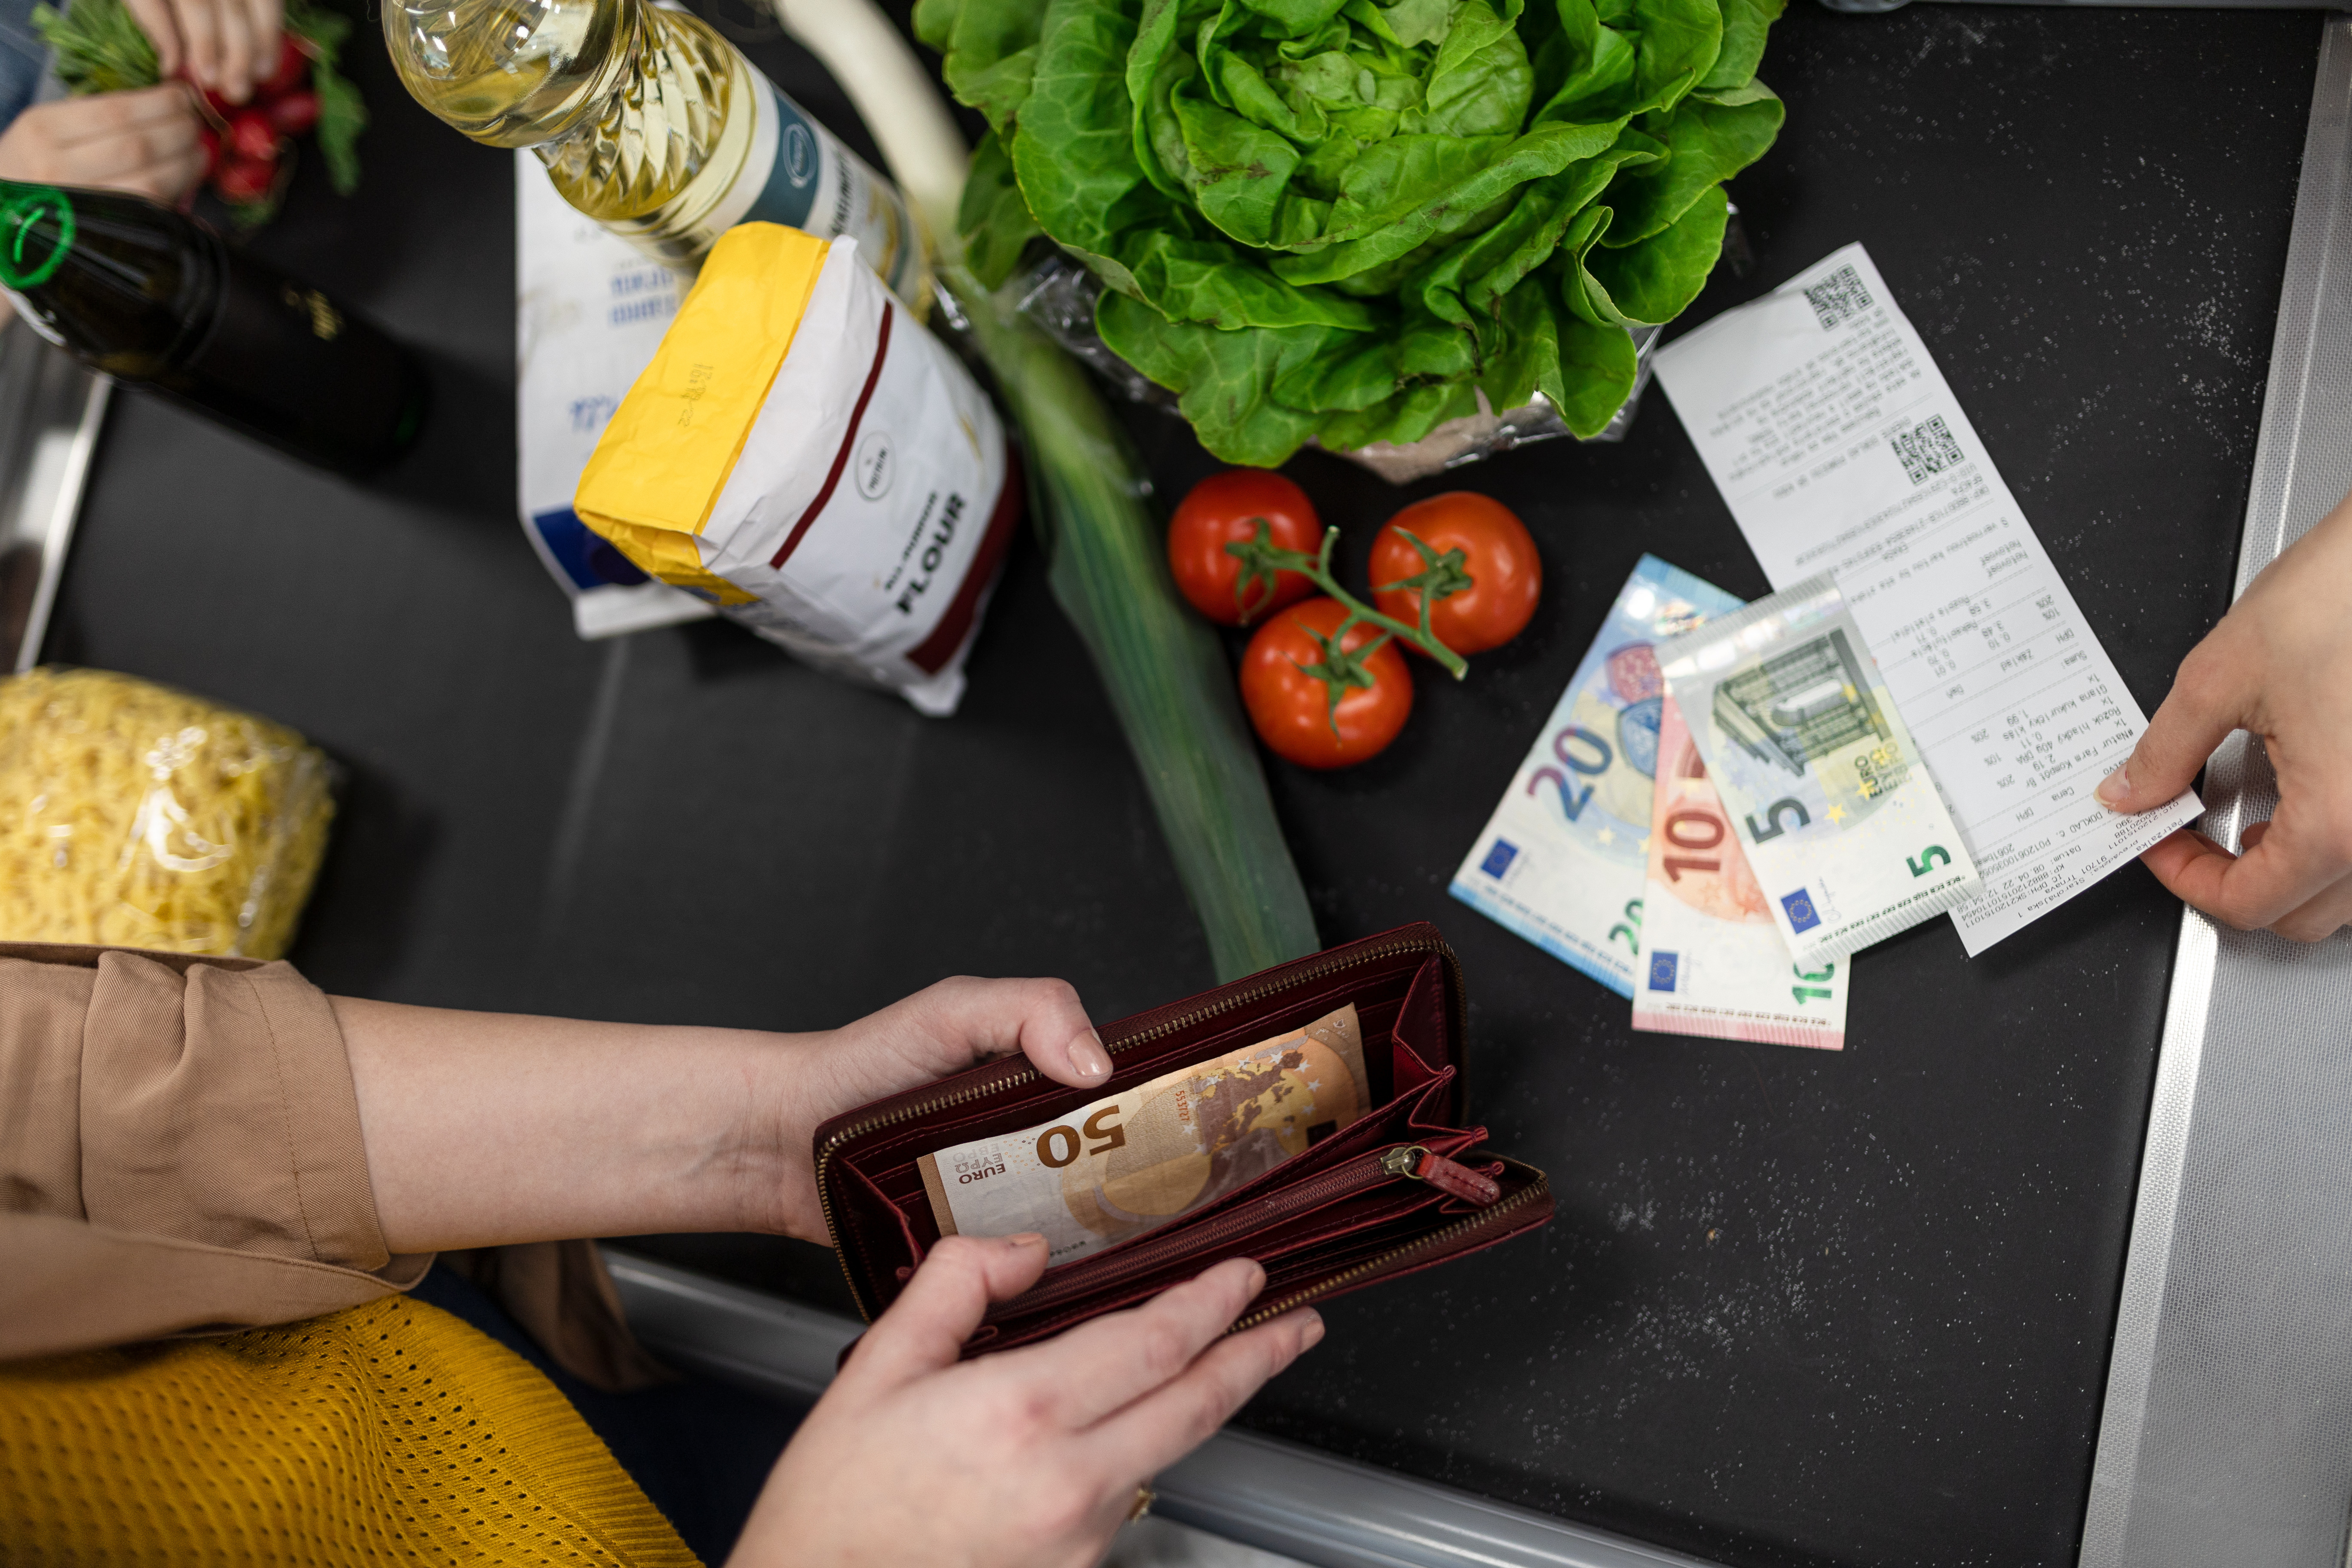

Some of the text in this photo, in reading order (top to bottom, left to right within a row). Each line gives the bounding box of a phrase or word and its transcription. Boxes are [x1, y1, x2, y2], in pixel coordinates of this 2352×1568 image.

[897, 493, 965, 616] FLOUR
[2035, 594, 2055, 611] 20%
[2041, 605, 2061, 622] 10%
[2055, 627, 2075, 644] DPH
[2059, 649, 2088, 670] Suma:
[2078, 683, 2108, 704] Giana
[2100, 695, 2113, 707] 1x
[1970, 672, 2100, 745] 1x 1.99 20%
[2027, 698, 2077, 730] kukuričky
[2091, 705, 2121, 726] Rožok
[2055, 720, 2090, 745] hladký
[2113, 717, 2127, 729] 1x
[2019, 730, 2043, 749] 0.11
[2035, 739, 2055, 756] 40g
[1983, 751, 2002, 768] 10%
[2024, 727, 2134, 790] #Natur Farm Kompót Br
[2031, 753, 2056, 772] 2.19
[1527, 725, 1613, 822] 20
[1996, 774, 2015, 790] 20%
[2015, 786, 2075, 823] Cena DPH
[1745, 796, 1811, 844] 5
[2068, 811, 2103, 833] DOKLAD
[1663, 808, 1724, 882] 10
[2135, 817, 2184, 853] Petržalka
[1906, 844, 1951, 878] 5
[2049, 844, 2081, 865] Dátum:
[2089, 839, 2139, 876] prevádzka:
[2001, 863, 2045, 890] 08.04.22
[2044, 854, 2107, 895] 91701 Trnava
[1955, 887, 1998, 913] 12:54:58
[1964, 881, 2048, 929] DPH:SK2120151011
[2027, 876, 2085, 913] Starohájska
[1036, 1105, 1126, 1168] 50
[959, 1163, 1006, 1184] EURO
